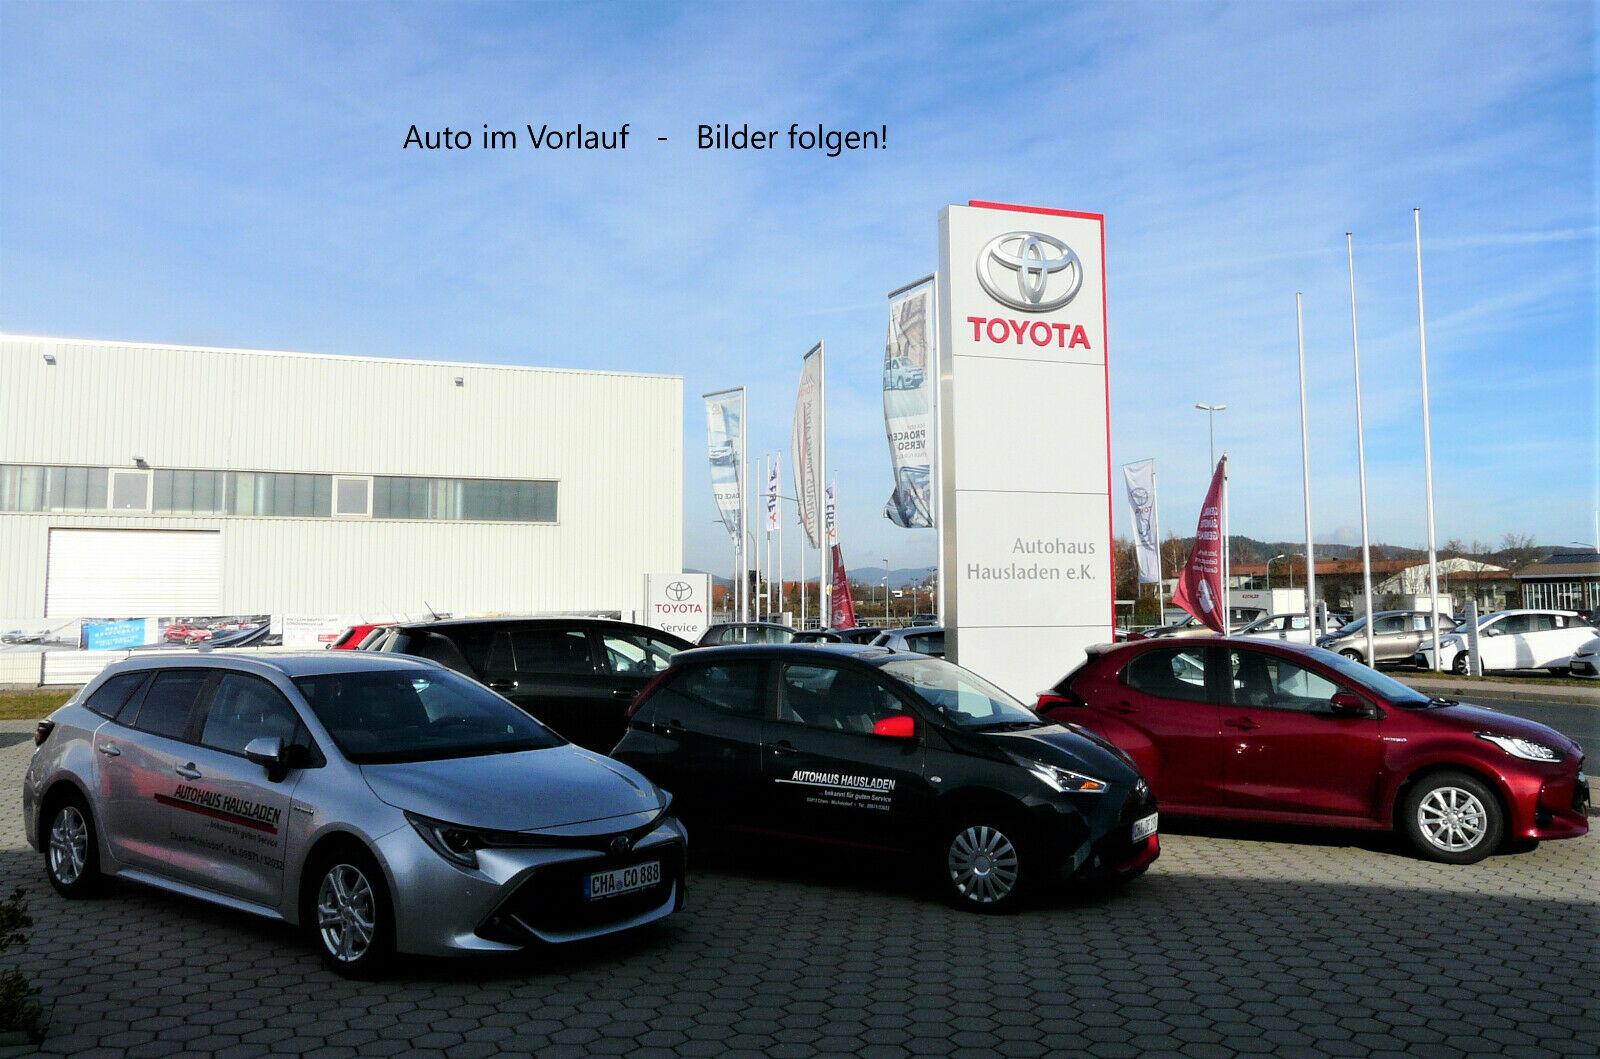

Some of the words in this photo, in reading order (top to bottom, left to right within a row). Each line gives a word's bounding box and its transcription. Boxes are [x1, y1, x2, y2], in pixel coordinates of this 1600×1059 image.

[967, 316, 1091, 349] TOYOTA
[1012, 537, 1096, 556] Autohaus
[967, 562, 1061, 581] Hausladen
[1066, 564, 1097, 581] e.K.
[655, 603, 703, 614] TOYOTA
[660, 622, 698, 633] Service
[791, 769, 840, 785] AUTOHAUS
[840, 774, 896, 791] HAUSLADEN
[174, 784, 222, 808] AUTOHAUS
[223, 796, 282, 824] HAUSLADEN
[871, 795, 892, 803] Service
[591, 873, 616, 895] CHA
[623, 868, 638, 888] CO
[640, 863, 659, 884] 888
